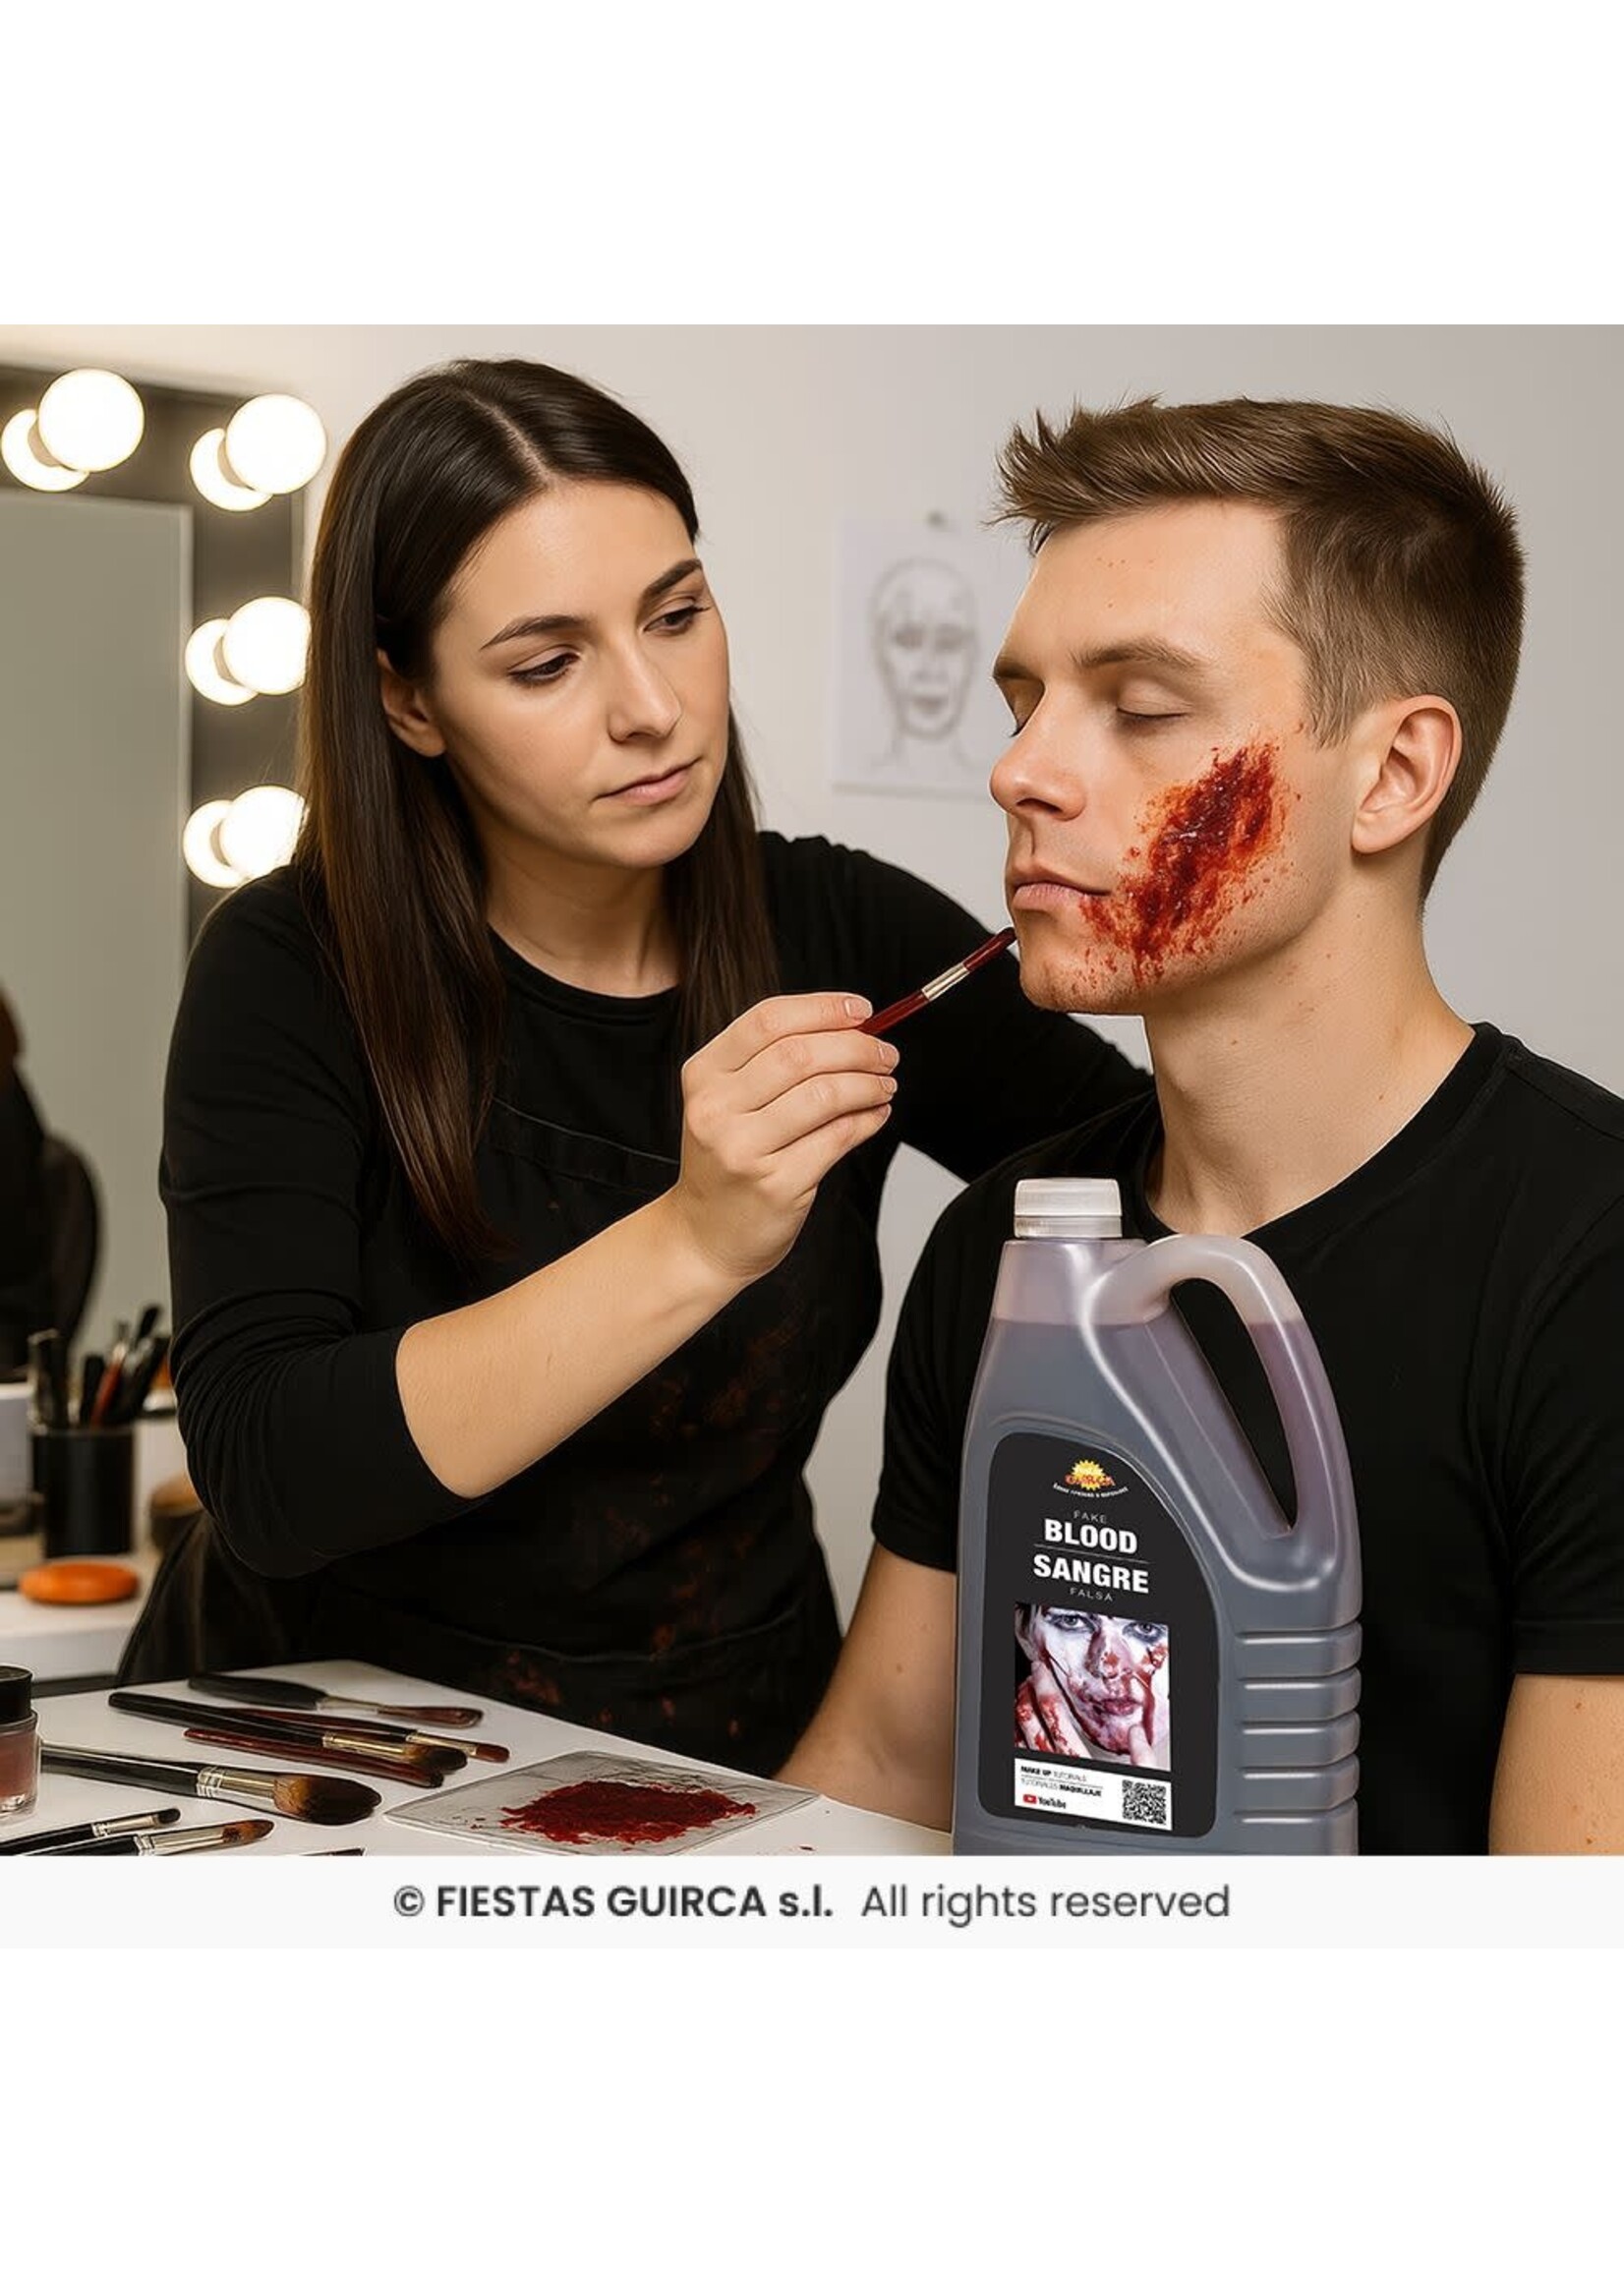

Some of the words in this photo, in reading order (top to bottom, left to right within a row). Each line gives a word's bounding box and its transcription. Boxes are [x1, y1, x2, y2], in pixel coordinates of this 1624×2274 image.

[1073, 1509, 1107, 1524] FAKE
[1044, 1518, 1137, 1553] BLOOD
[1033, 1553, 1149, 1594] SANGRE
[1070, 1587, 1113, 1603] FALSA
[1020, 1766, 1040, 1775] MAKE
[1059, 1783, 1102, 1797] MAQUILLAJE
[1038, 1796, 1067, 1809] YouTube
